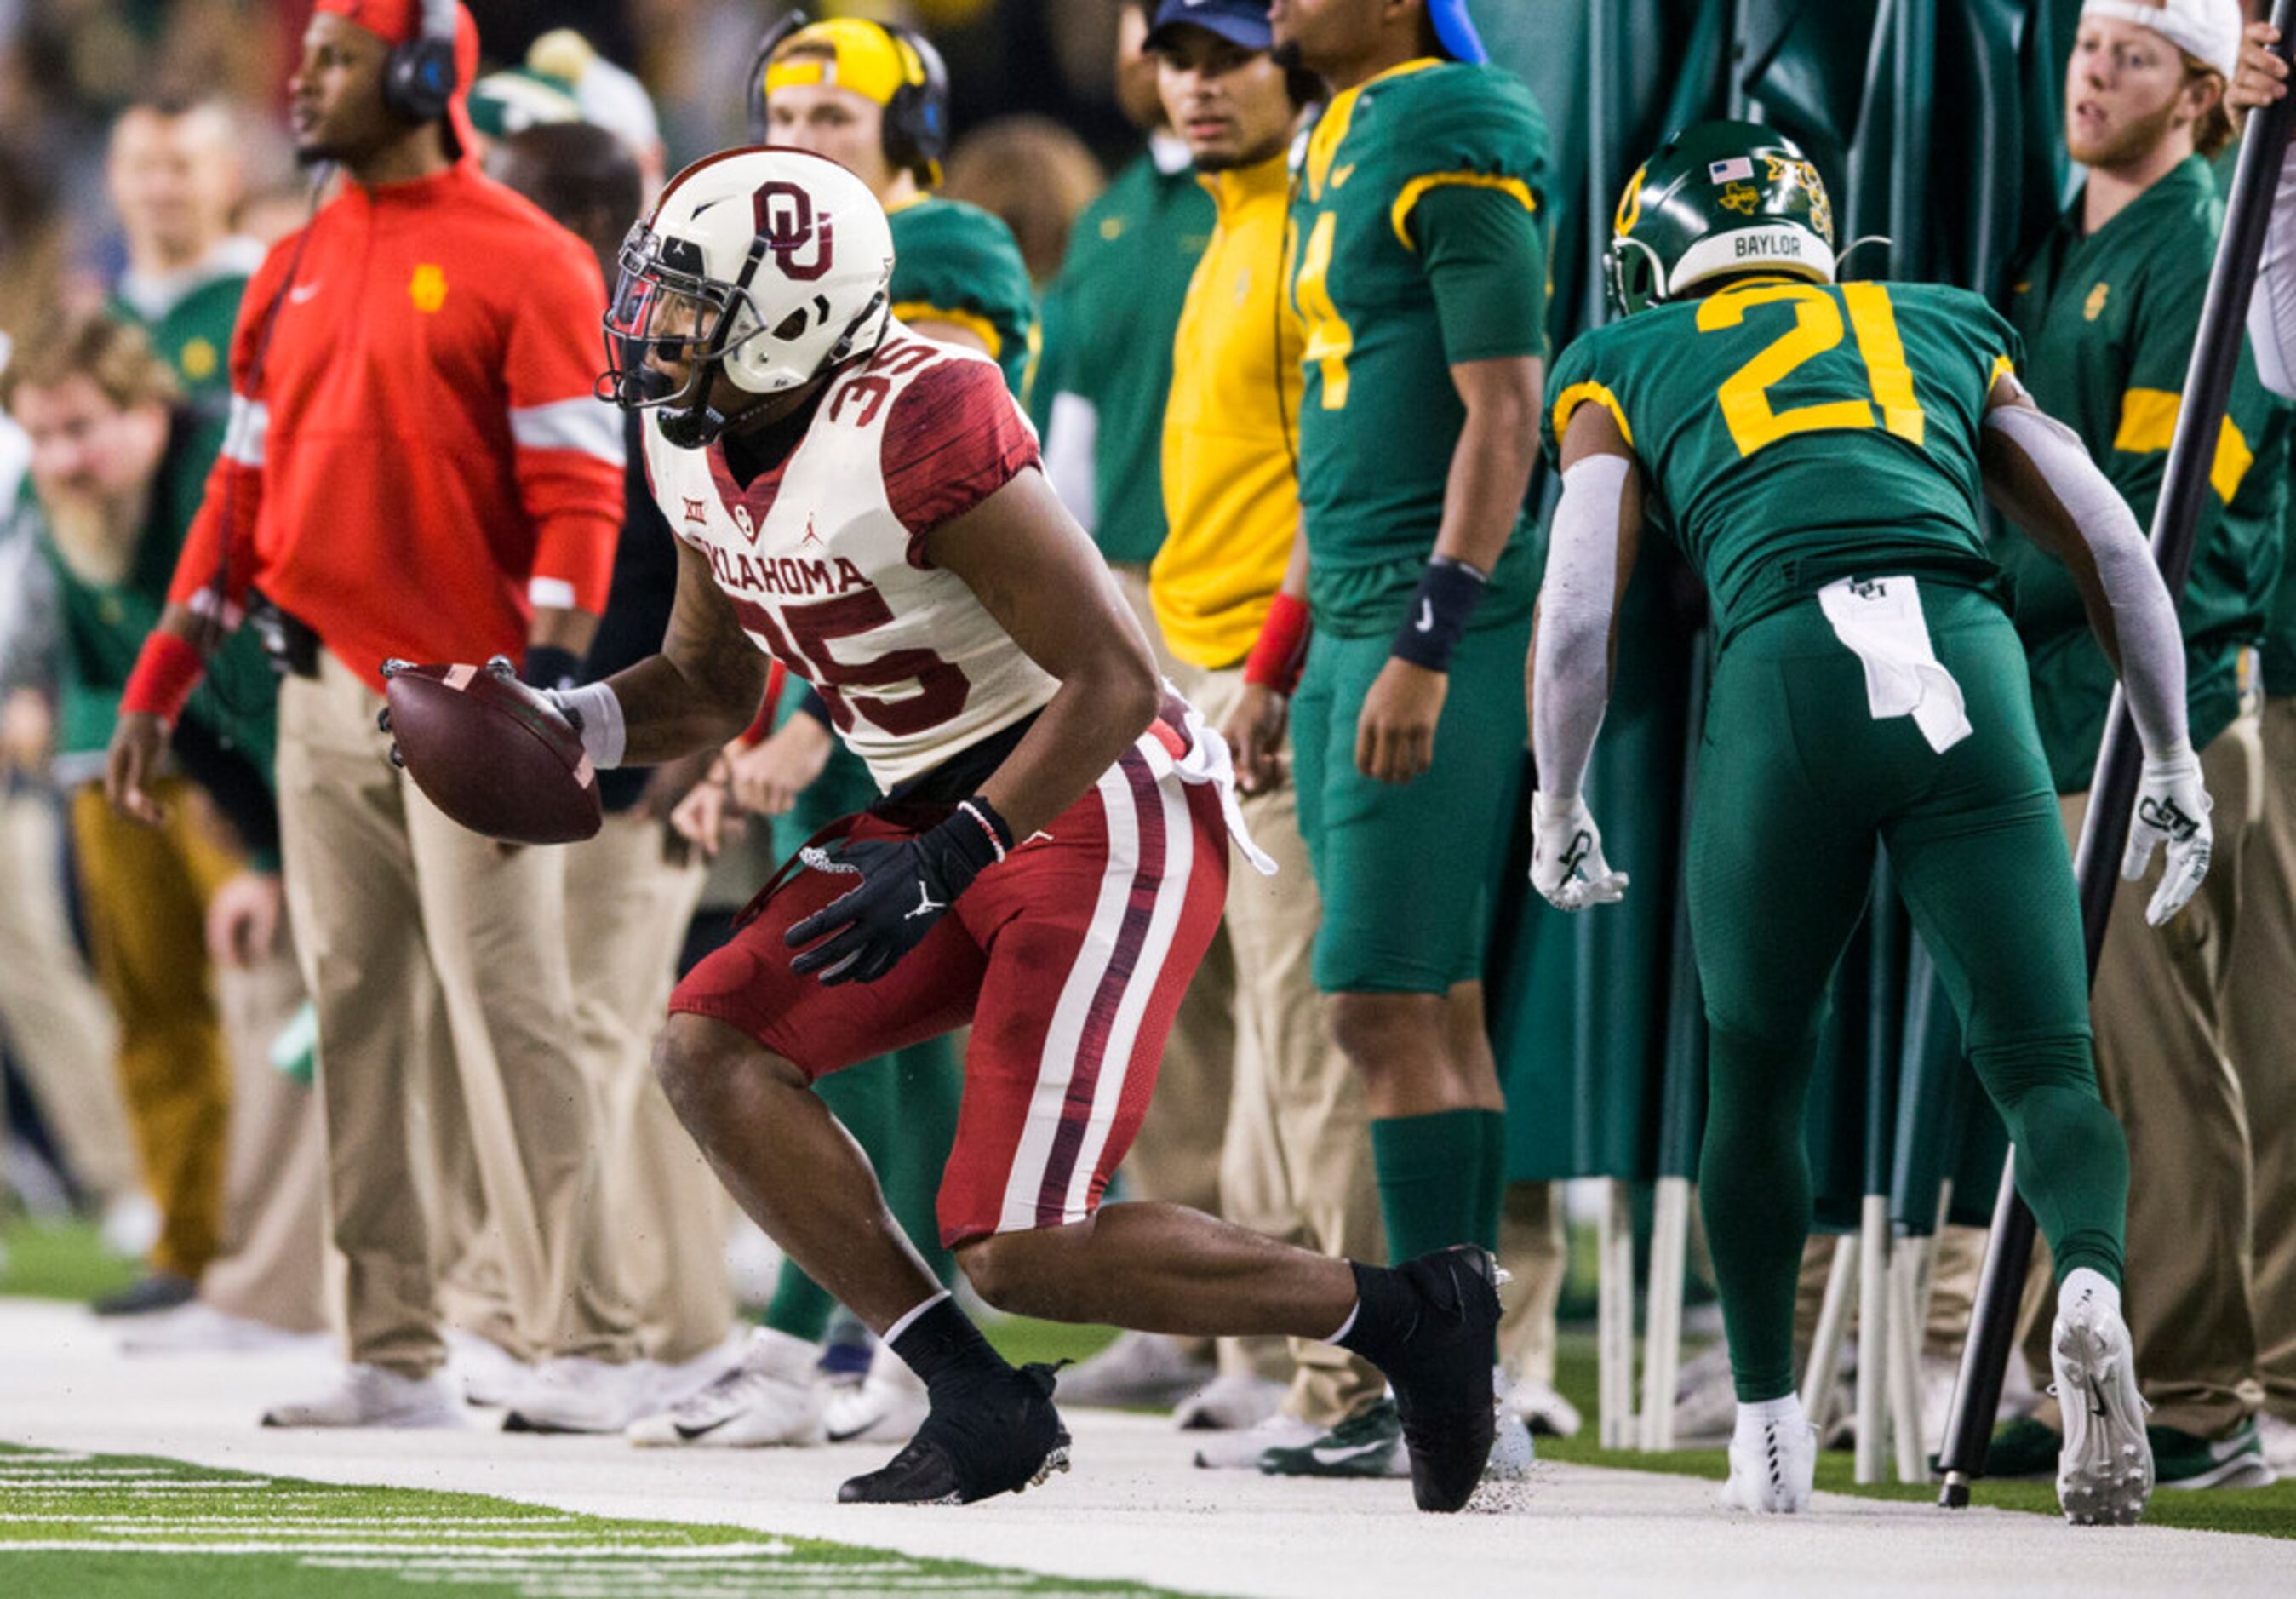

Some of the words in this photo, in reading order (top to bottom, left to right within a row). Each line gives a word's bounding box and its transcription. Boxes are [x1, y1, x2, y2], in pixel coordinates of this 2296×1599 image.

[753, 181, 833, 281] OU
[1735, 235, 1801, 257] BAYLOR
[1284, 210, 1354, 410] 4
[828, 337, 941, 427] 35
[1696, 279, 1925, 458] 21
[691, 535, 872, 595] KLAHOMA
